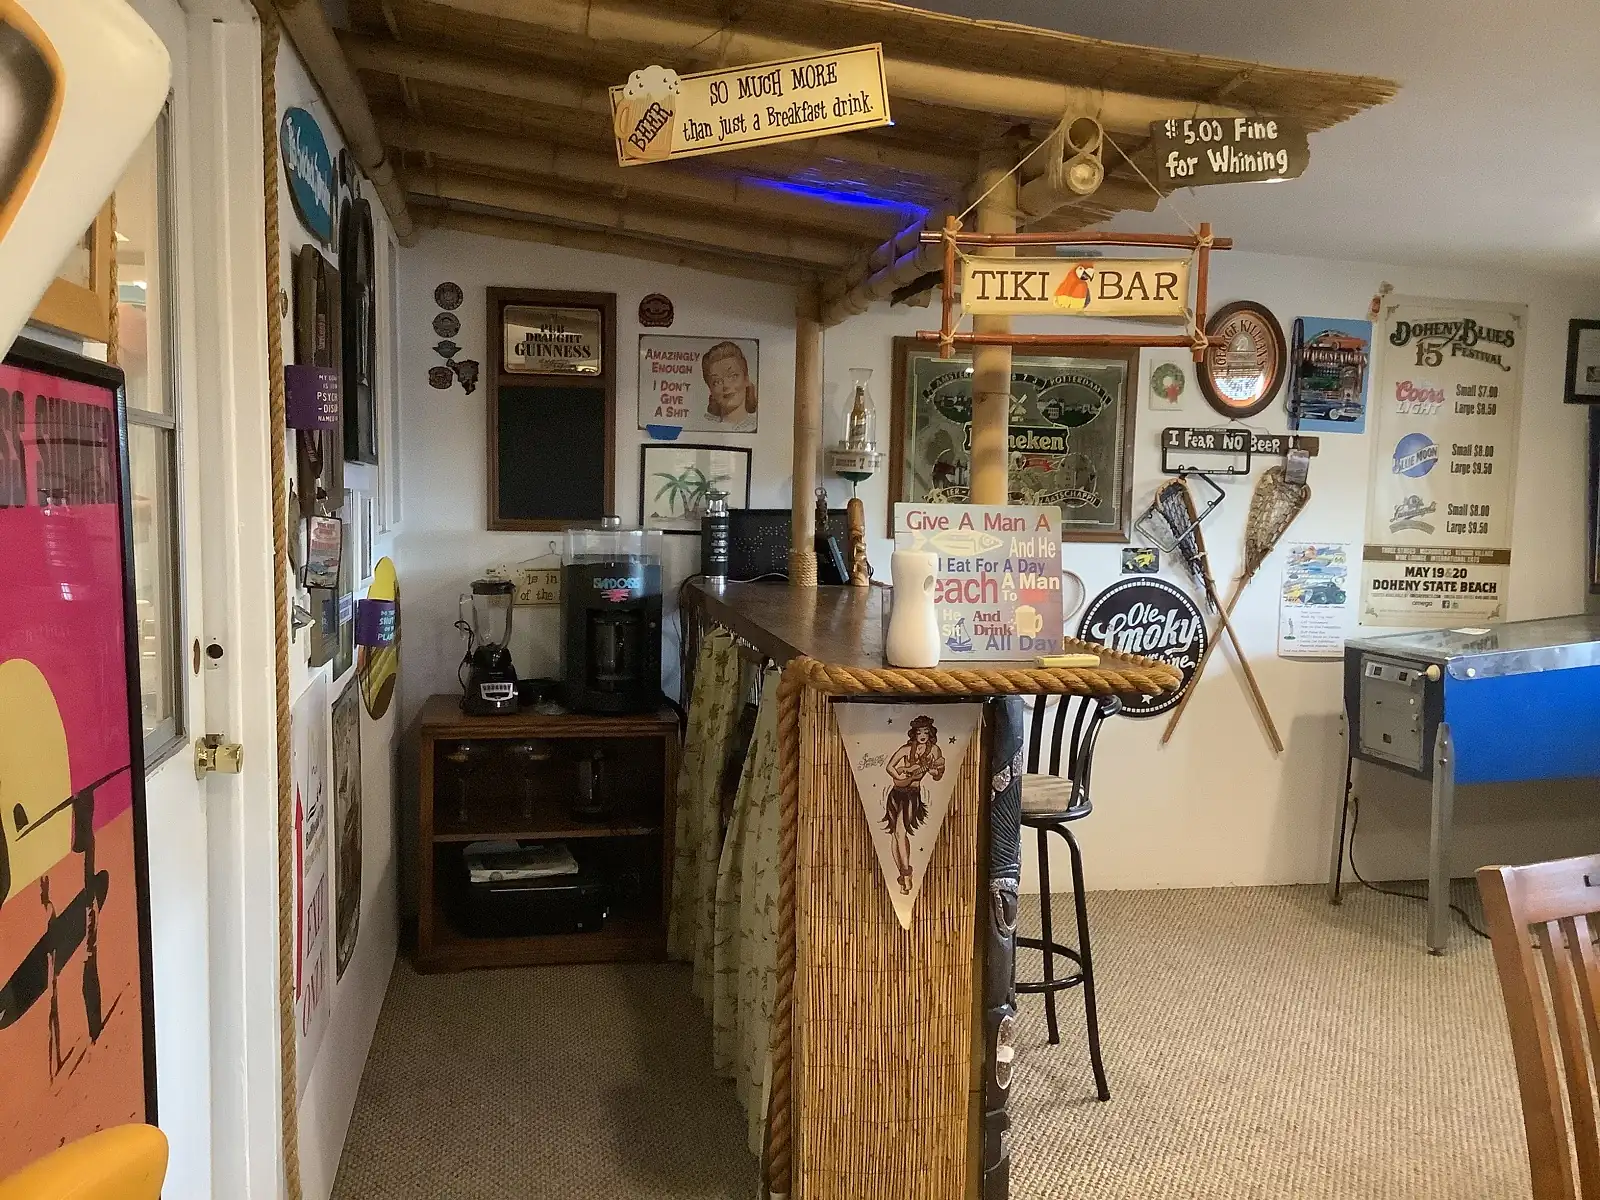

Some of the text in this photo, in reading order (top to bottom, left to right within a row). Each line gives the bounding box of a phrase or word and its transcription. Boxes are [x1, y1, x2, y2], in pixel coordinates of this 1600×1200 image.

[710, 62, 838, 106] SO MUCH MORE
[683, 91, 874, 141] than just a Breakfast drink.
[628, 101, 673, 152] BEER
[1234, 118, 1278, 142] Fine
[1165, 145, 1288, 178] for Whining
[971, 270, 1179, 301] TIKI BAR
[525, 332, 582, 343] DRAUGHT
[1389, 321, 1463, 348] DOHENY
[514, 342, 591, 359] GUINNESS
[1414, 342, 1444, 367] 15
[1456, 383, 1476, 397] Small
[654, 406, 663, 417] A
[1454, 402, 1474, 415] Large
[1169, 430, 1180, 446] I
[1452, 443, 1473, 457] Small
[1450, 462, 1471, 475] Large
[1448, 503, 1468, 516] Small
[906, 510, 1051, 532] Give A Man A
[1446, 521, 1467, 534] Large
[1009, 536, 1056, 558] And He
[947, 558, 971, 573] Eat
[975, 558, 999, 573] For
[1003, 558, 1013, 573] A
[1018, 559, 1046, 576] Day
[1404, 566, 1430, 578] MAY
[527, 573, 558, 585] is in
[1372, 579, 1497, 593] DOHENY STATE BEACH
[520, 588, 553, 600] of the
[934, 571, 1060, 604] each A Man
[1002, 590, 1018, 602] To
[973, 610, 1001, 622] And
[1128, 602, 1166, 627] Ole
[974, 624, 1012, 637] Drink
[1091, 609, 1200, 655] Smoky
[985, 634, 1011, 651] All
